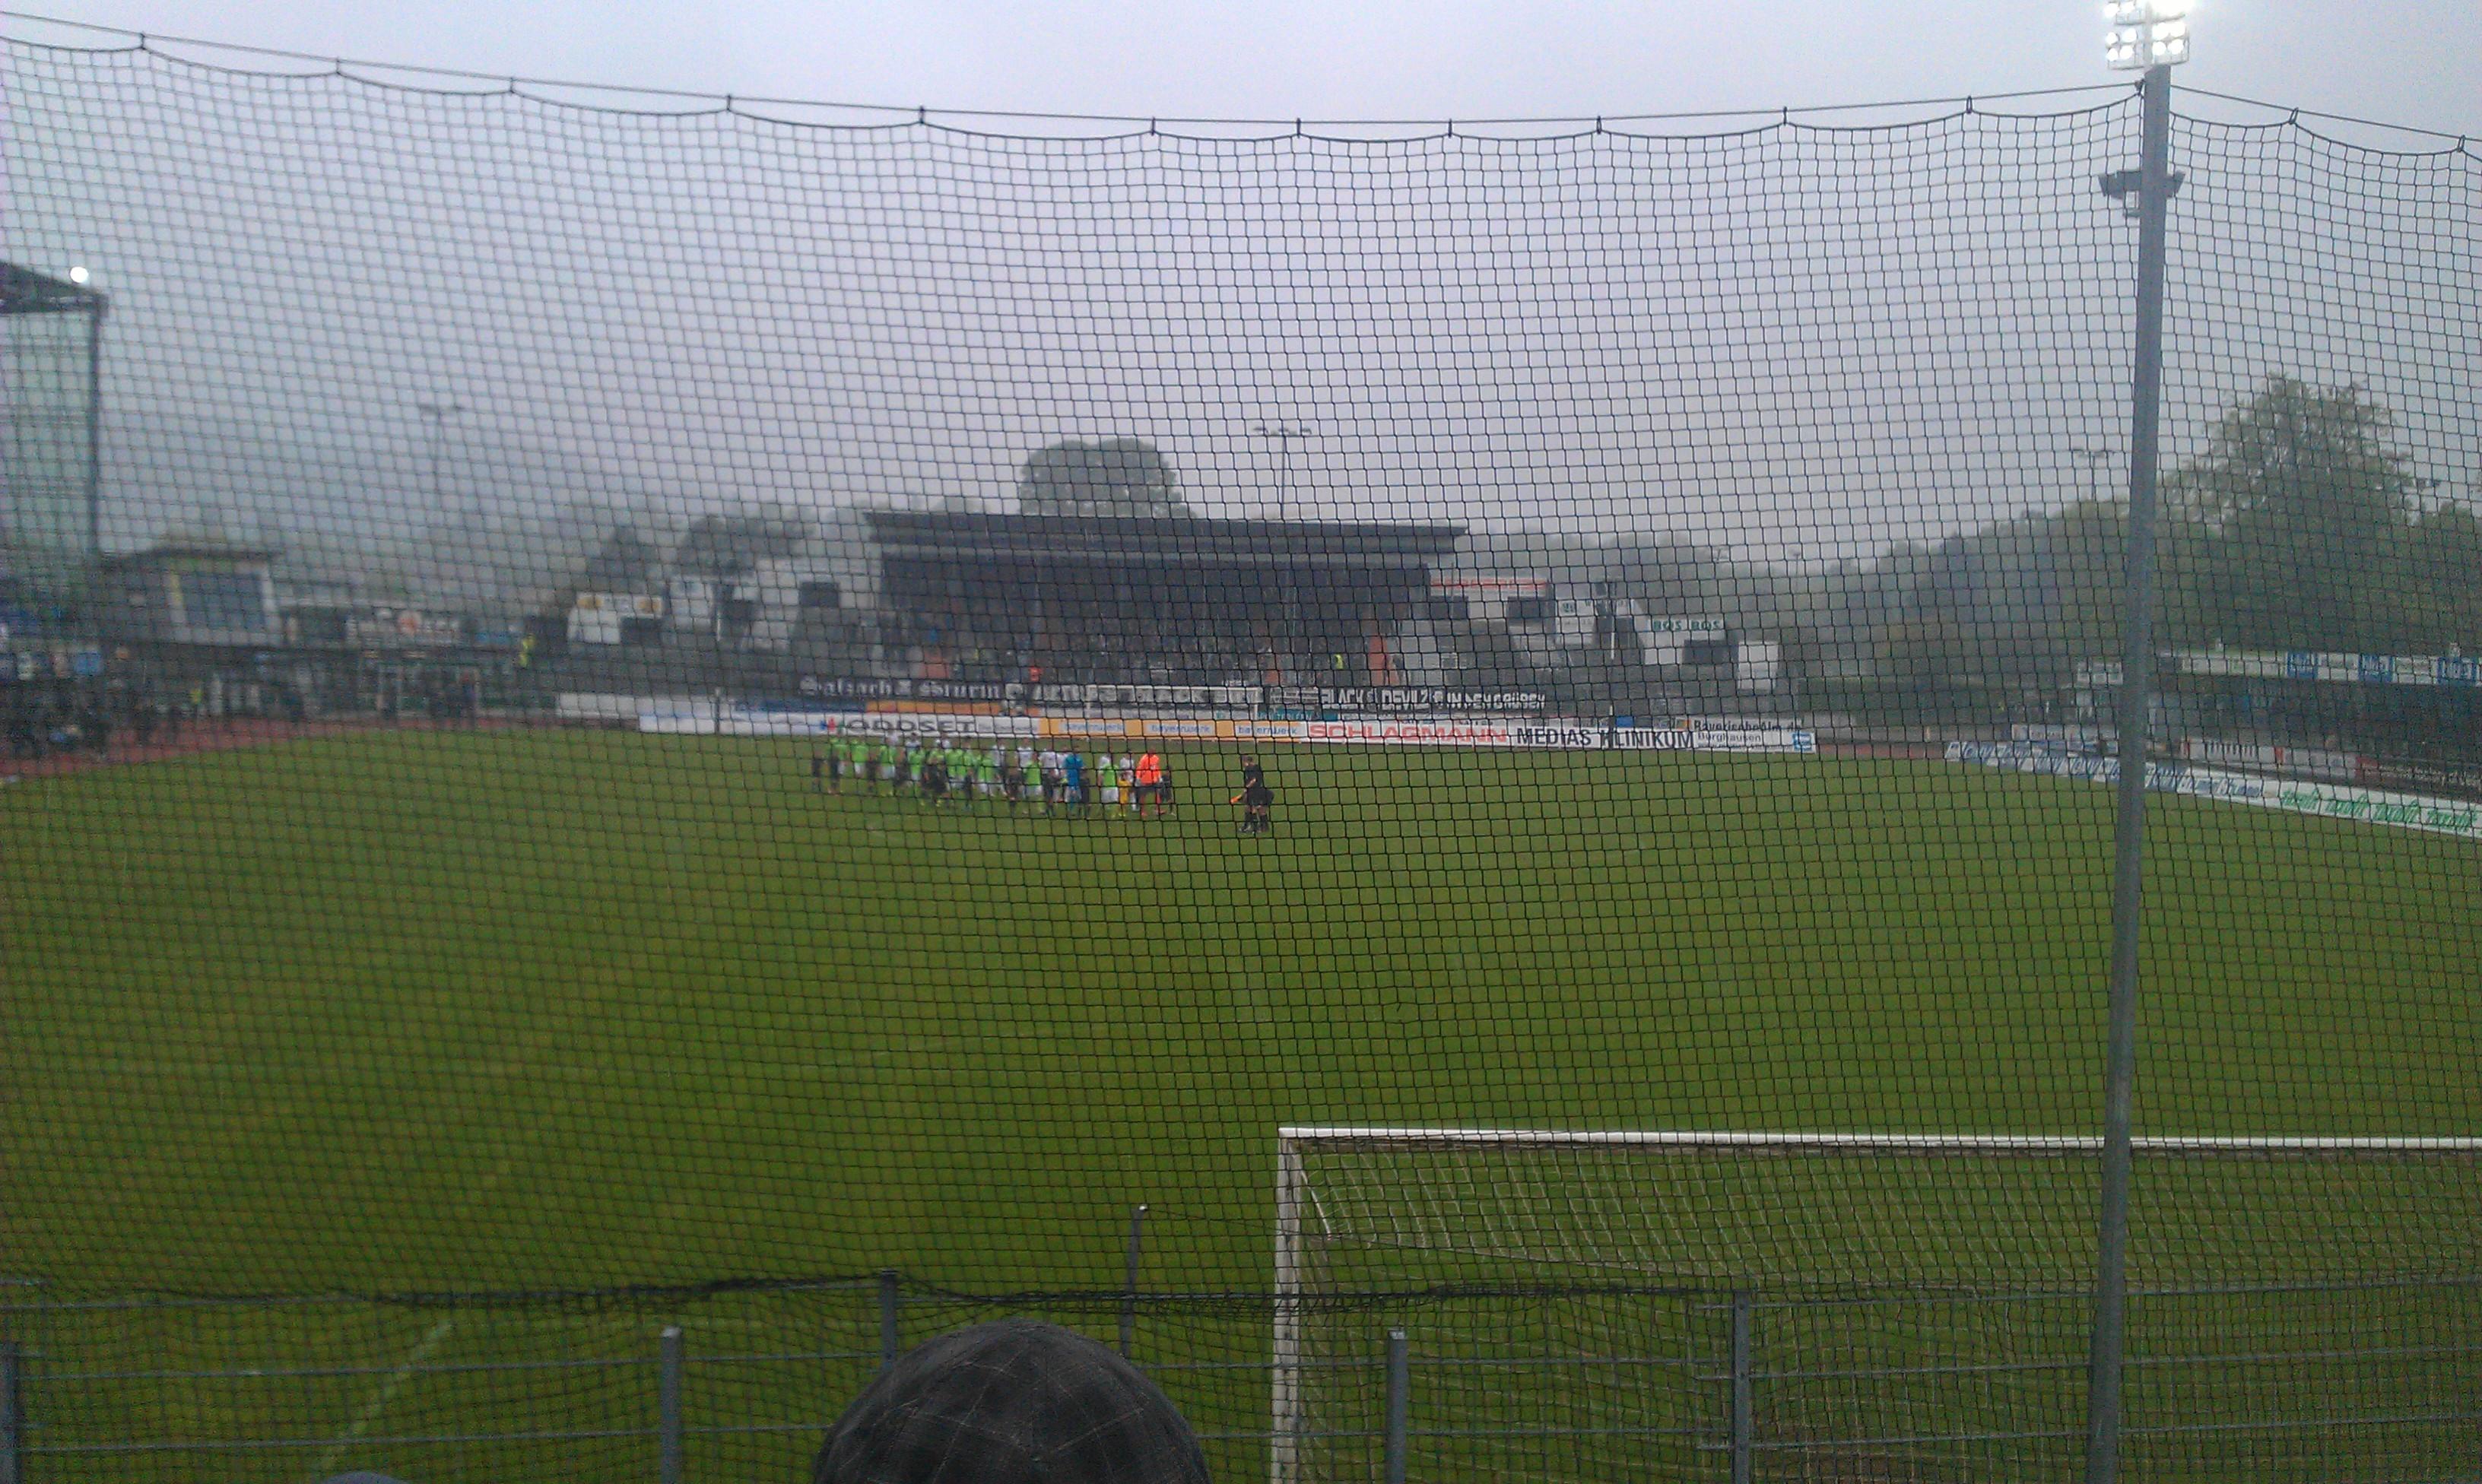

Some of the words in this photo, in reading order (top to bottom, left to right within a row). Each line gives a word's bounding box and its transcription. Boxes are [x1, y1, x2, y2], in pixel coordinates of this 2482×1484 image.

[846, 719, 976, 733] ODDSET
[1238, 725, 1298, 737] baernwerk
[1308, 723, 1507, 743] SCHLAGMANN
[1517, 728, 1592, 747] MEDIAS
